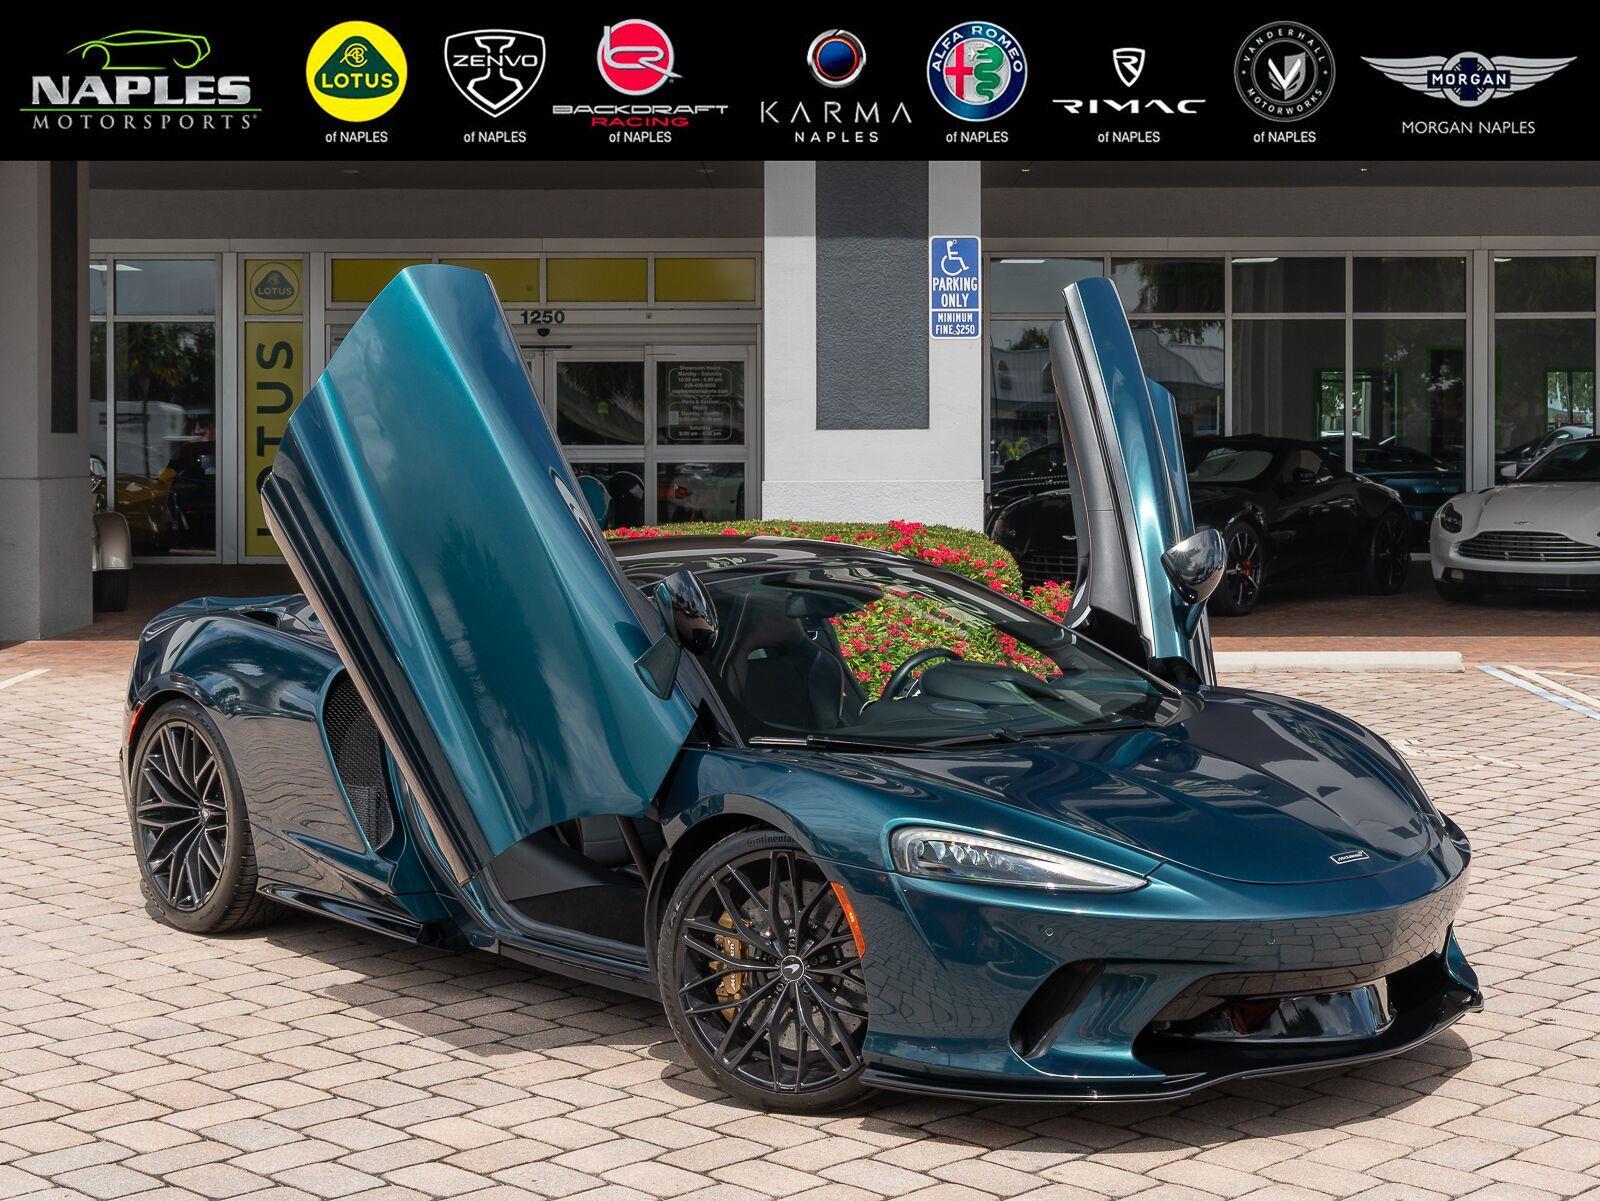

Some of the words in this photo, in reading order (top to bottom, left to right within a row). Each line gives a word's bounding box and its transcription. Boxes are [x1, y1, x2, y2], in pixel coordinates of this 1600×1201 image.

[258, 287, 292, 296] LOTUS
[932, 277, 978, 292] PARKING
[941, 294, 970, 308] ONLY
[520, 309, 565, 324] 1250
[938, 312, 973, 323] MINIMUM
[936, 324, 954, 335] FINE
[956, 324, 976, 336] $250
[256, 340, 294, 537] TUS
